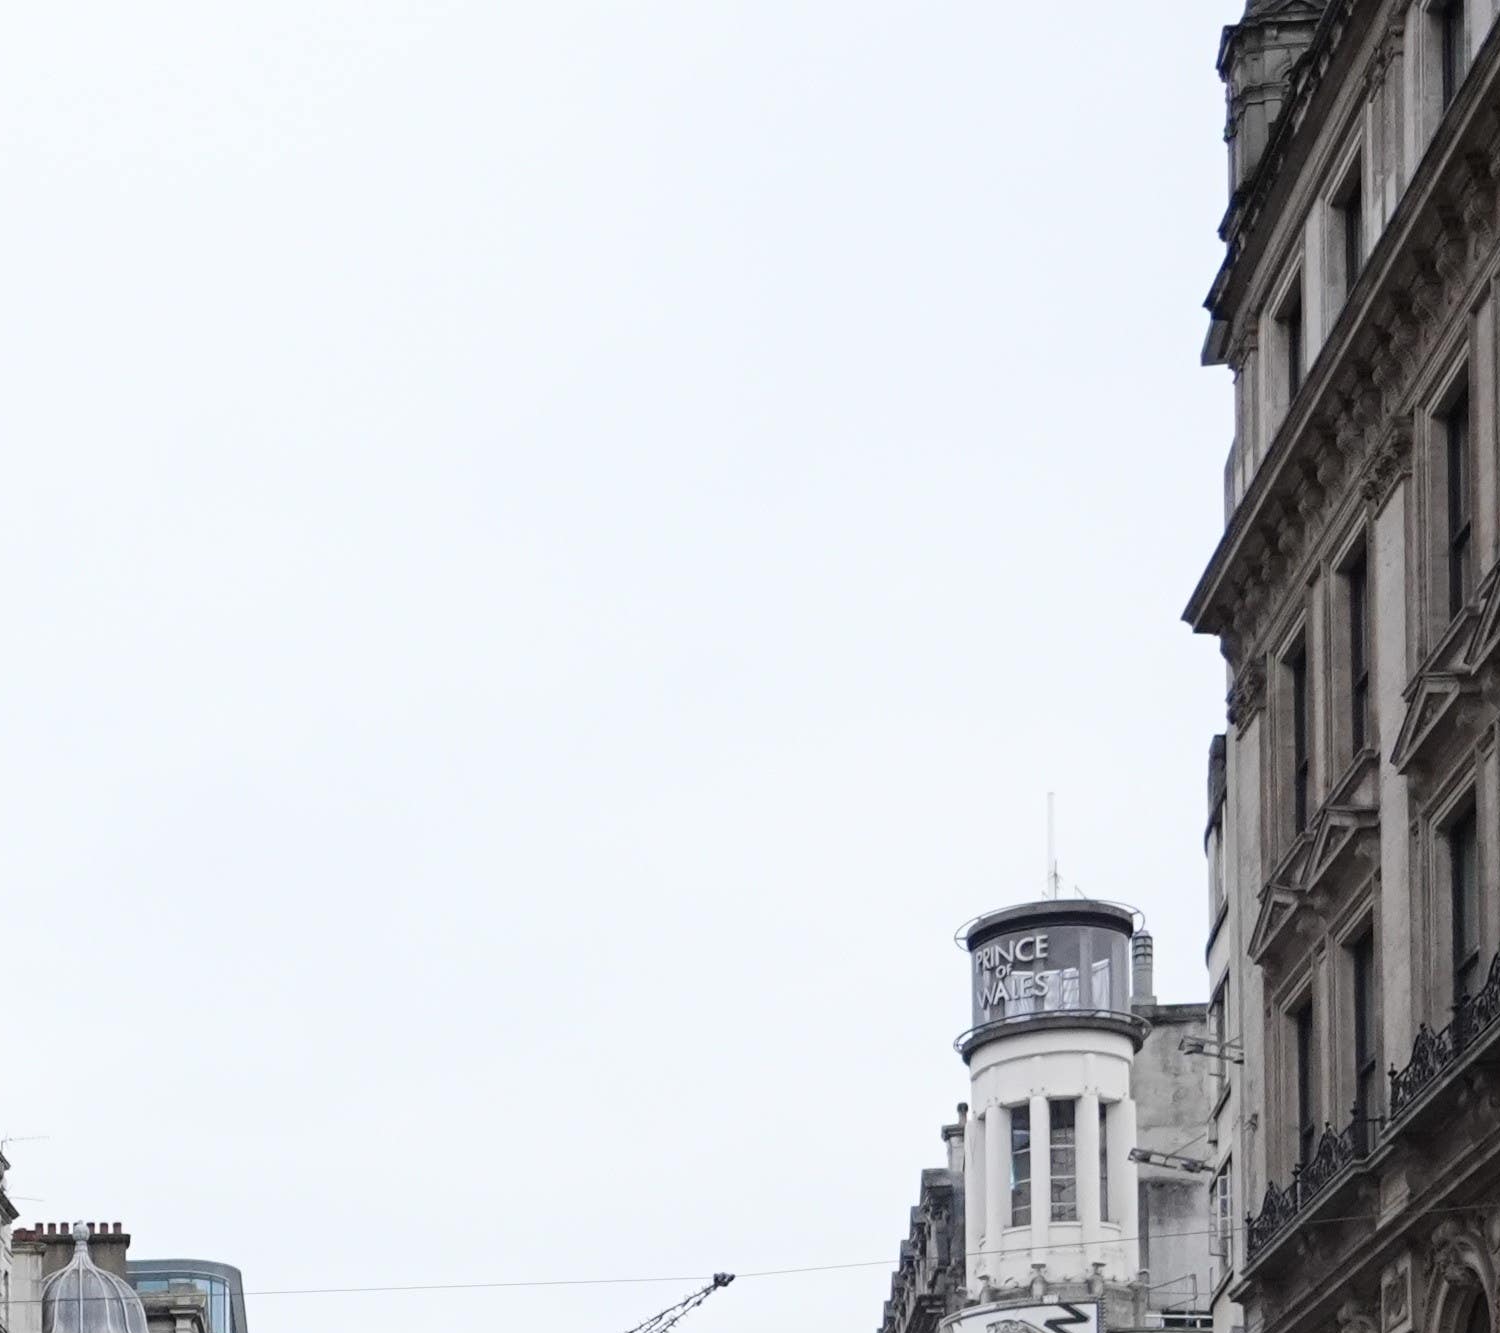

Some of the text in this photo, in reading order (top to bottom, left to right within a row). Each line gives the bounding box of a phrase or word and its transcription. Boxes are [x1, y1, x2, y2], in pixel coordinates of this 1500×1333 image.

[976, 935, 1049, 970] PRINCE
[995, 963, 1013, 978] OF
[977, 973, 1050, 1010] WALES
